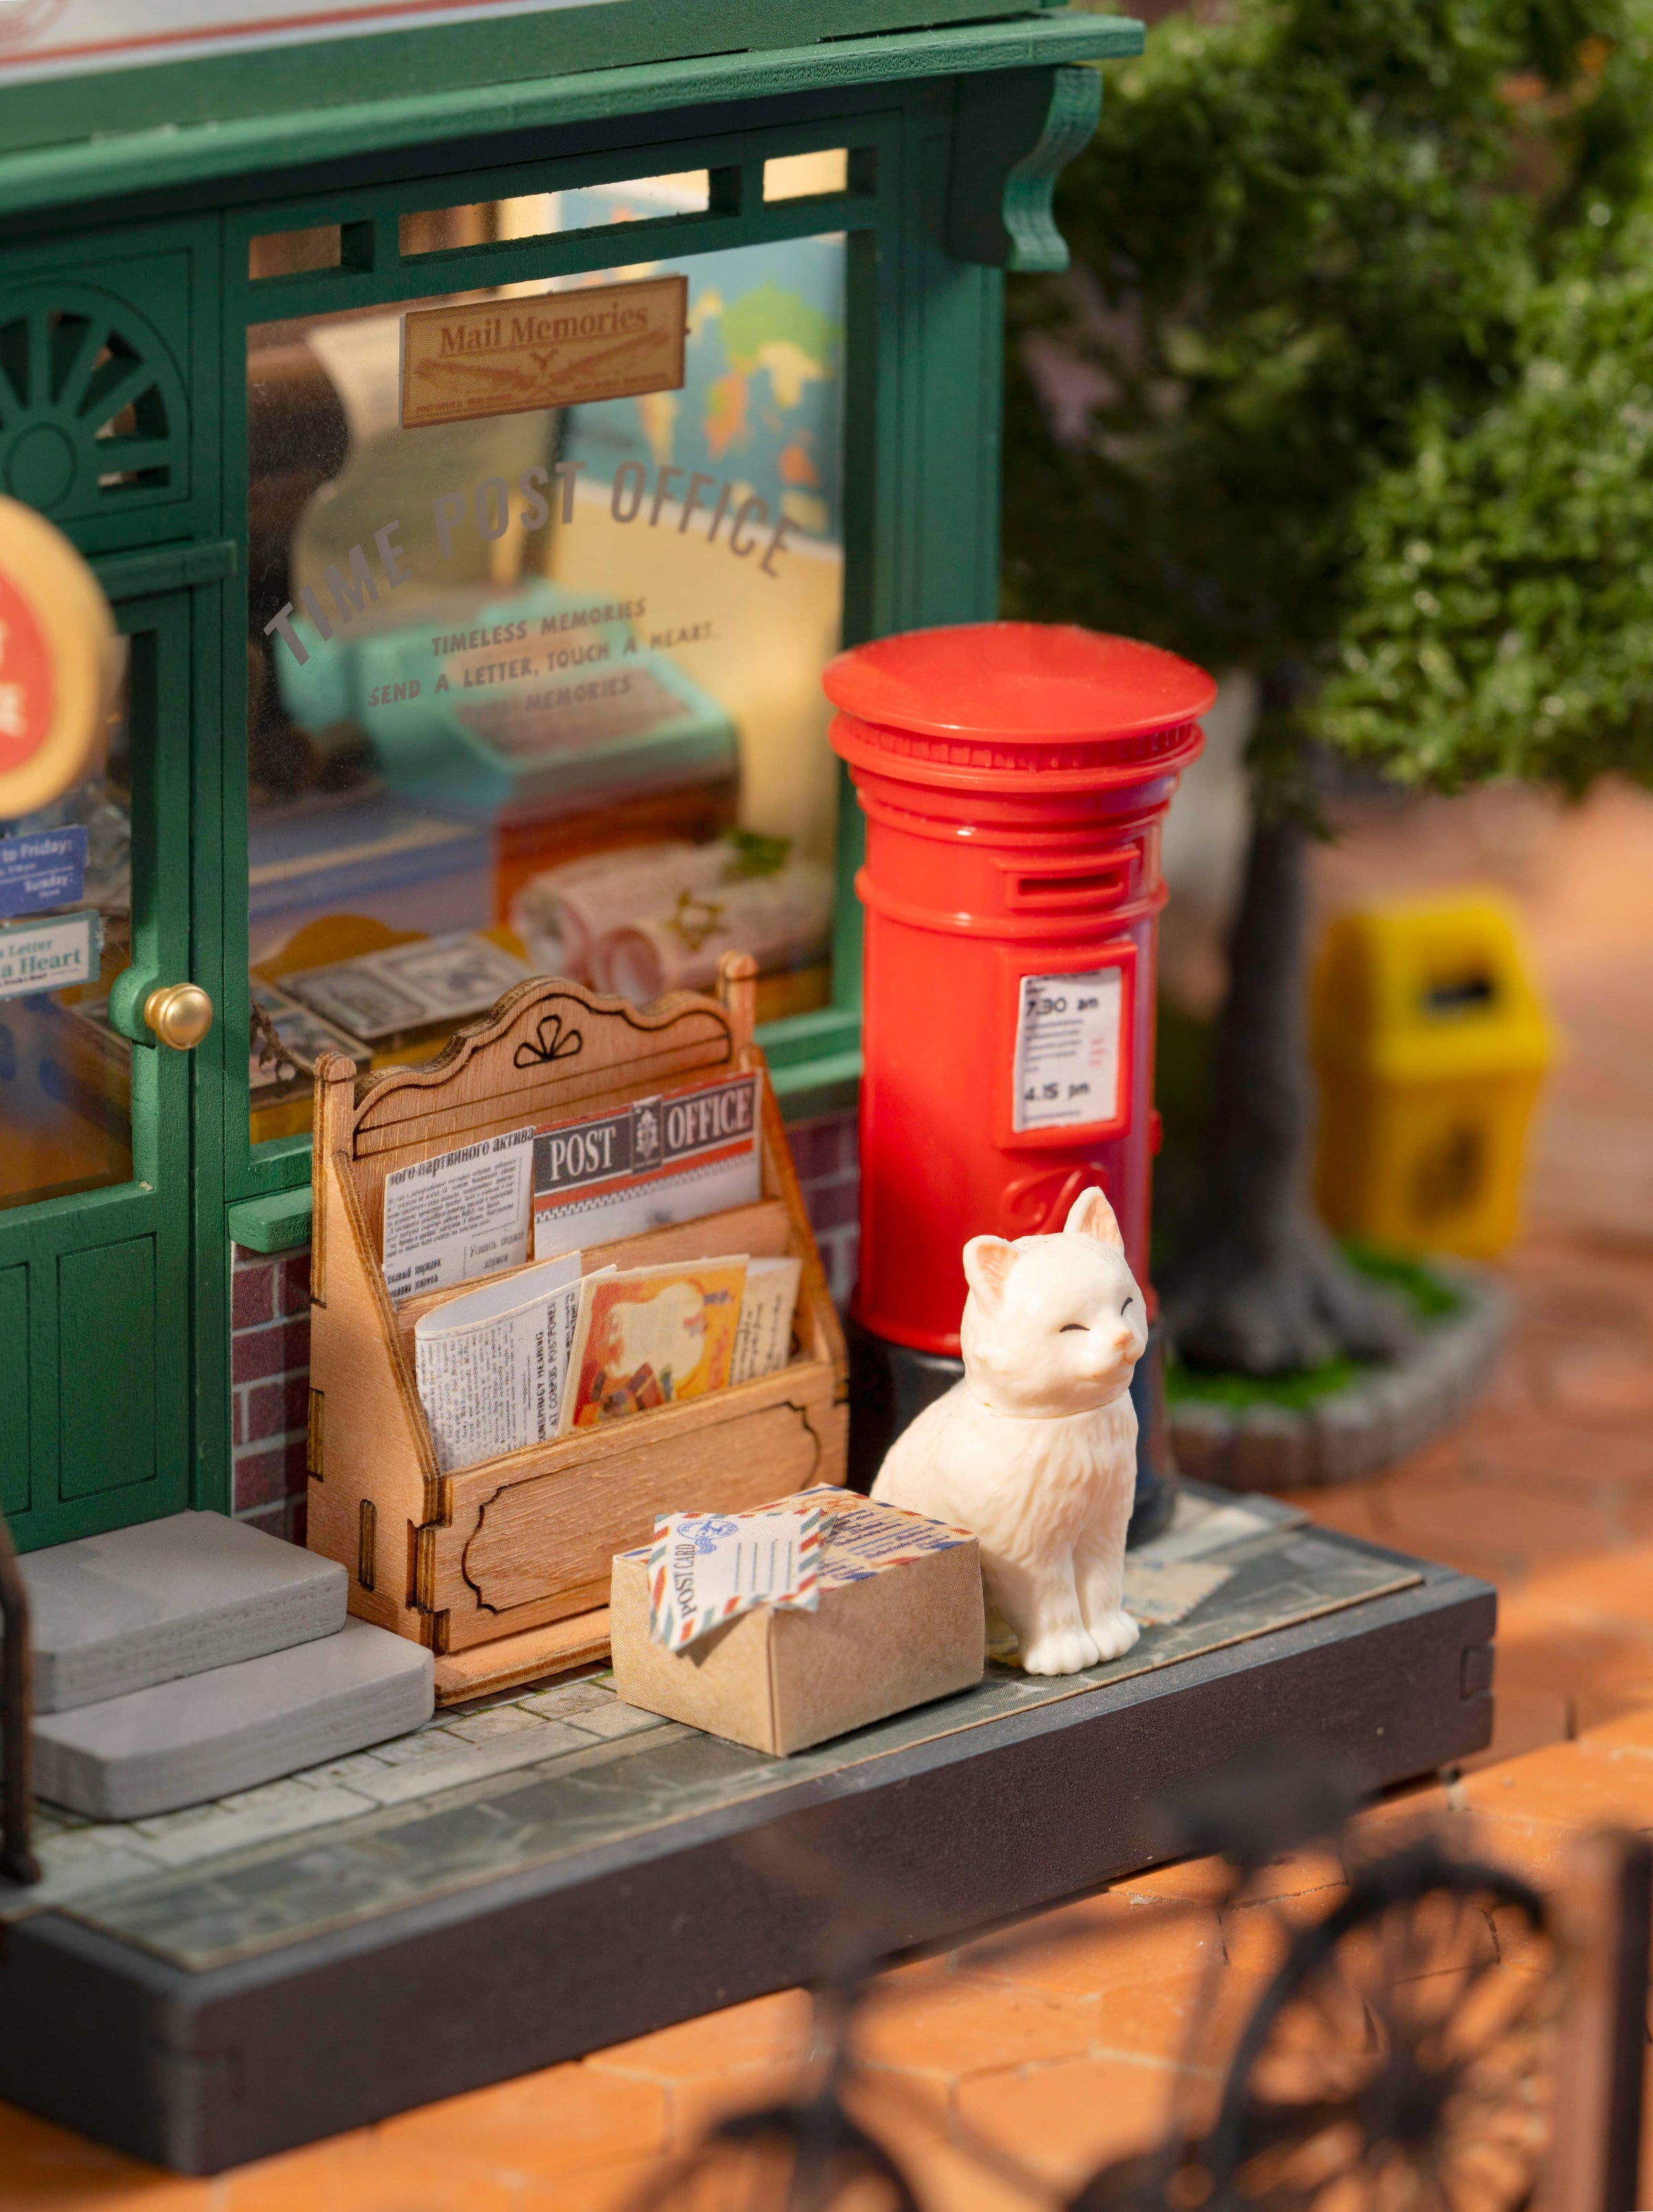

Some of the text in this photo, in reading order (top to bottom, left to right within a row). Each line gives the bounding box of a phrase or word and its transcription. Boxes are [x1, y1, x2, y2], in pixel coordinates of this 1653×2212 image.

[441, 303, 647, 354] Mail Memories
[263, 460, 800, 666] TIME POST OFFICE
[432, 597, 647, 657] TIMELESS MEMORIES
[367, 679, 421, 707] SEND
[435, 673, 450, 694] A
[464, 657, 539, 688] LETTER,
[548, 641, 610, 670] TOUCH
[623, 634, 638, 654] A
[526, 675, 632, 713] MEMORIES
[9, 939, 53, 956] Letter
[20, 949, 82, 974] Heart
[1026, 998, 1099, 1016] 7.30 am
[1024, 1082, 1091, 1101] 4.15 pm
[550, 1086, 752, 1181] POST OFFICE
[672, 1543, 697, 1618] POST CARD
